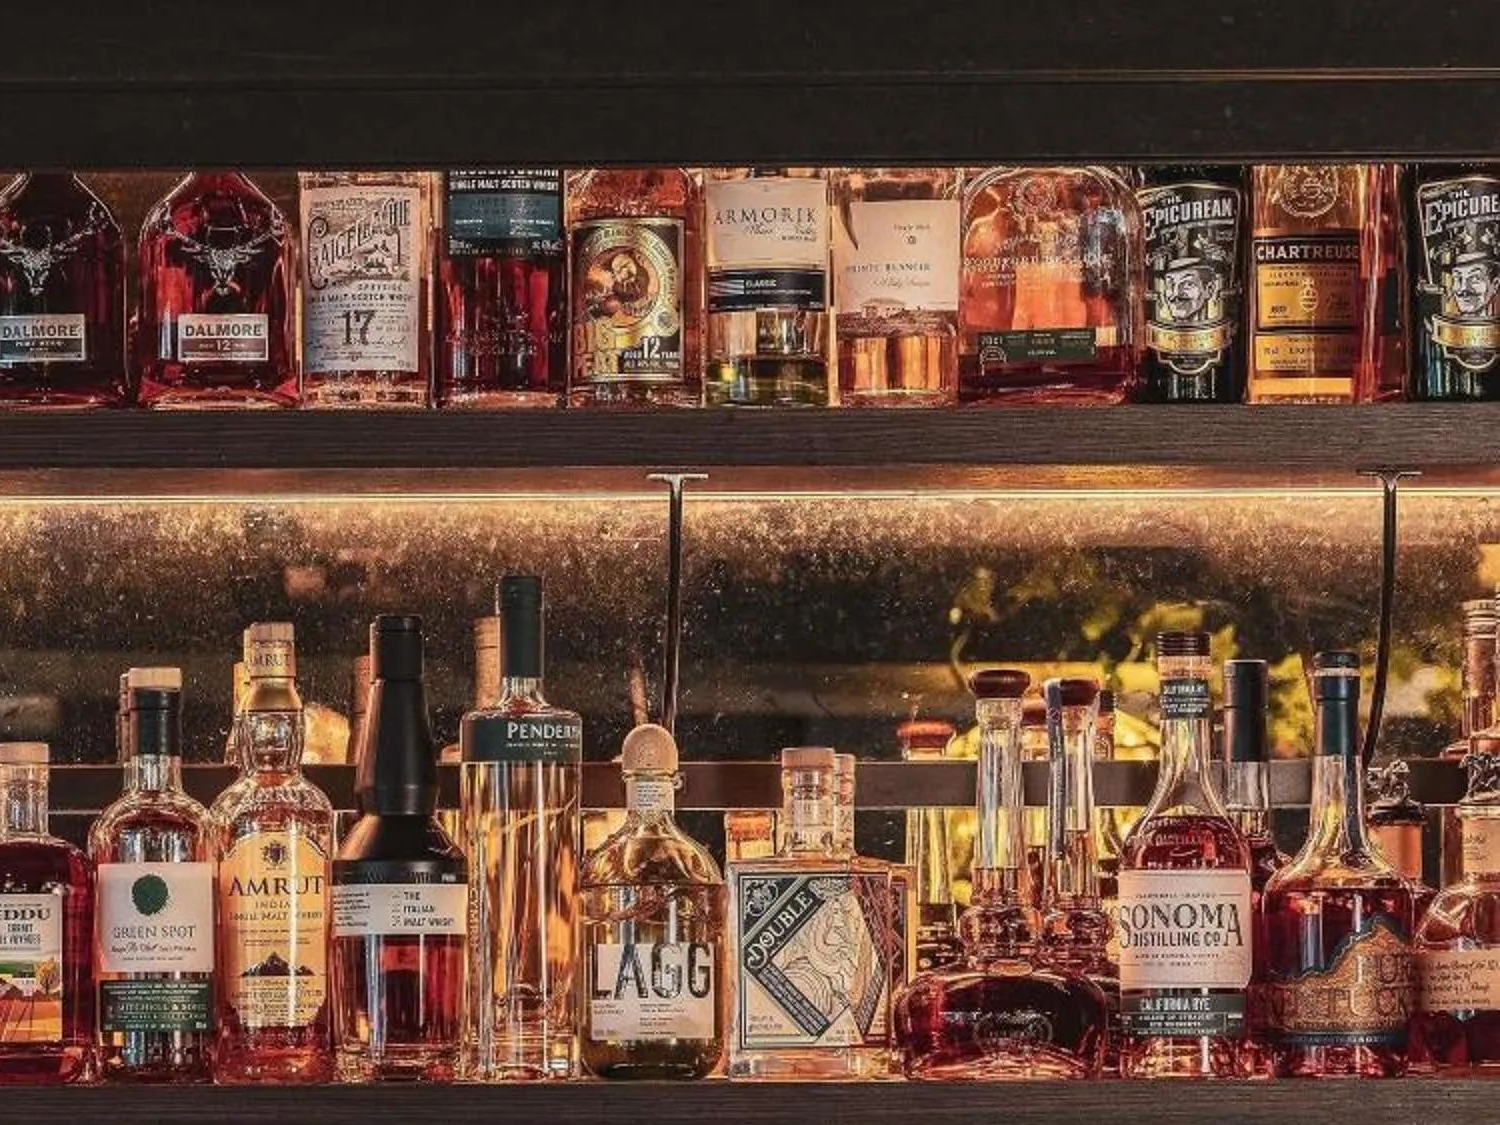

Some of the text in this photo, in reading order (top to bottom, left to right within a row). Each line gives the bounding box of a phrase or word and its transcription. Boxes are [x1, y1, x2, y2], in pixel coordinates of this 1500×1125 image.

[713, 206, 817, 226] ARMORIK
[1143, 199, 1234, 240] EPICUREAN
[1257, 245, 1359, 260] CHARTREUSE
[3, 323, 79, 338] DALMORE
[185, 323, 262, 337] DALMORE
[342, 310, 376, 346] 17
[215, 340, 230, 351] 12
[642, 336, 661, 359] 12
[228, 876, 324, 897] AMRUT
[255, 900, 300, 909] INDIA
[113, 924, 197, 939] GREEN SPOT
[747, 890, 815, 969] DOUBLE
[1119, 903, 1244, 949] SONOMA
[1133, 931, 1200, 947] DISTILLING
[591, 941, 712, 999] LAGG
